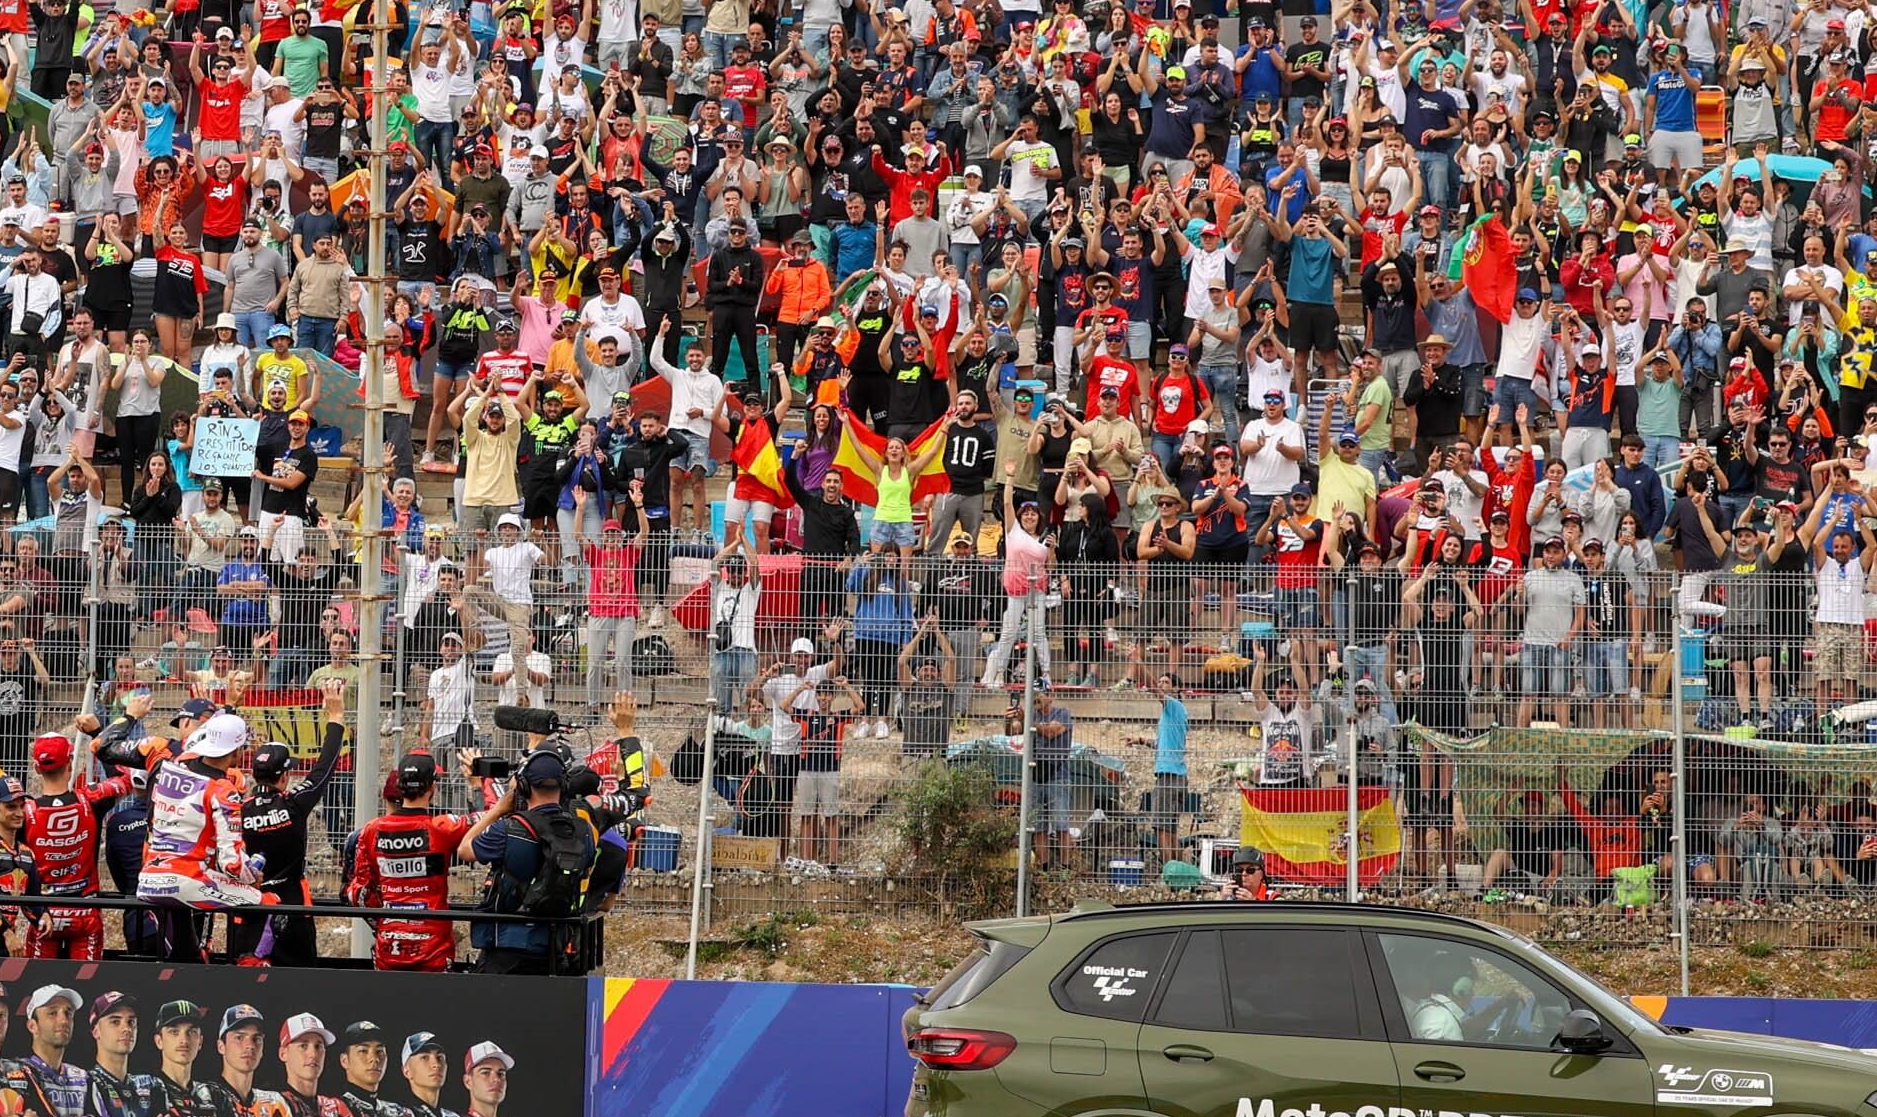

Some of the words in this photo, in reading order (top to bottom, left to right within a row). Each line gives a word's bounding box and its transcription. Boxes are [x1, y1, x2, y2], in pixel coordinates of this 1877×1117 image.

[950, 435, 979, 468] 10
[243, 808, 291, 832] aprilia
[35, 829, 89, 847] GASGAS
[403, 885, 429, 894] Sport
[1083, 965, 1125, 977] Official
[1127, 967, 1148, 978] Car
